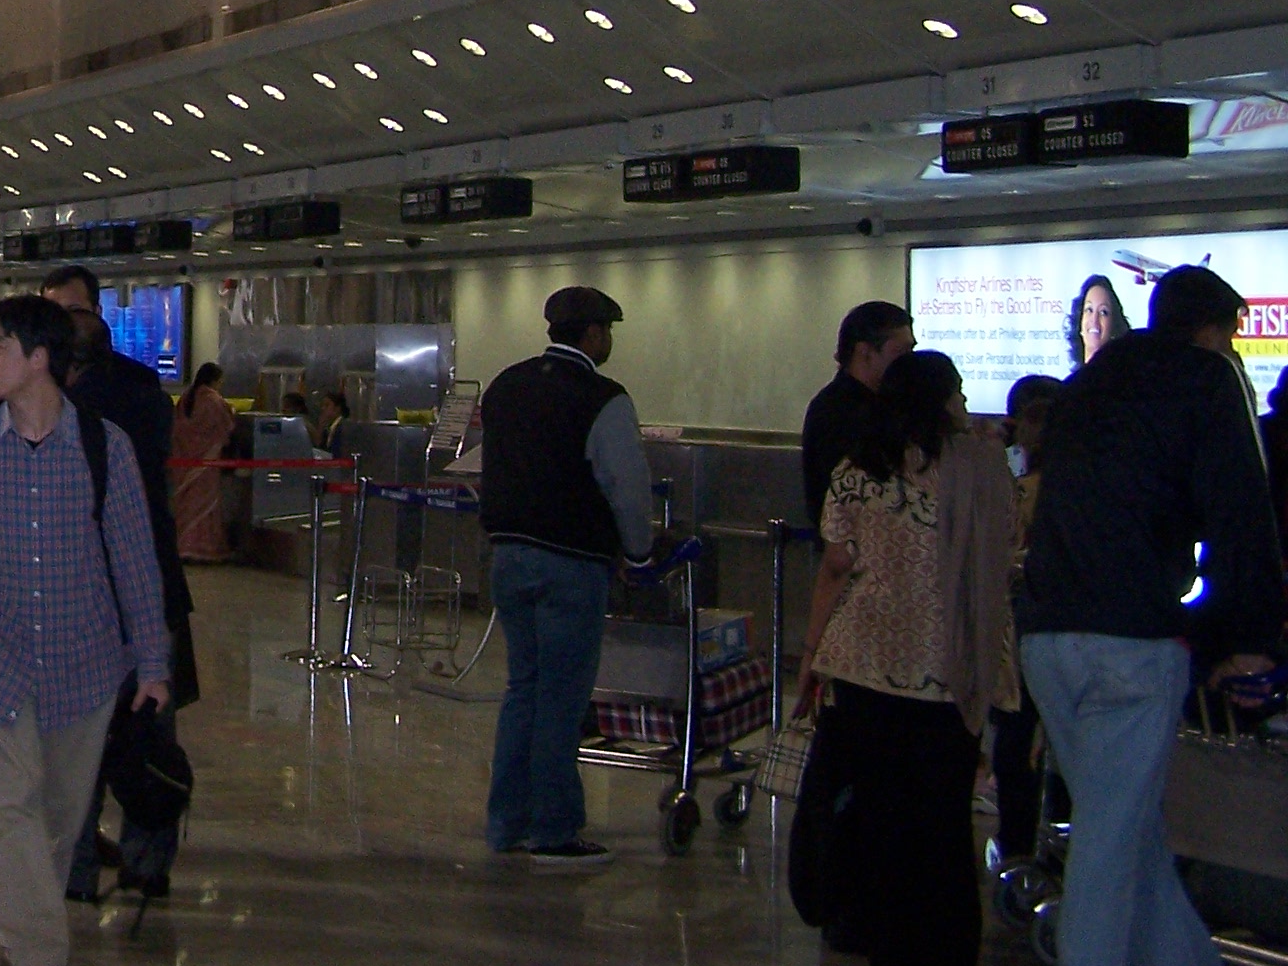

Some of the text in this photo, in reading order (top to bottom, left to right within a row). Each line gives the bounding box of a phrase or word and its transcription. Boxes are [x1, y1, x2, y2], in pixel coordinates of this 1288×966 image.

[1082, 62, 1101, 81] 32
[982, 76, 996, 95] 31
[1044, 131, 1124, 151] COUNTER CLOSED
[946, 144, 1019, 162] COUNTER CLOSED
[936, 275, 1043, 296] Kingfisher Airlines invites
[917, 298, 961, 315] Jet-Setters
[964, 299, 972, 314] to
[975, 297, 987, 318] Fly
[991, 298, 1004, 314] the
[1006, 297, 1031, 314] Good
